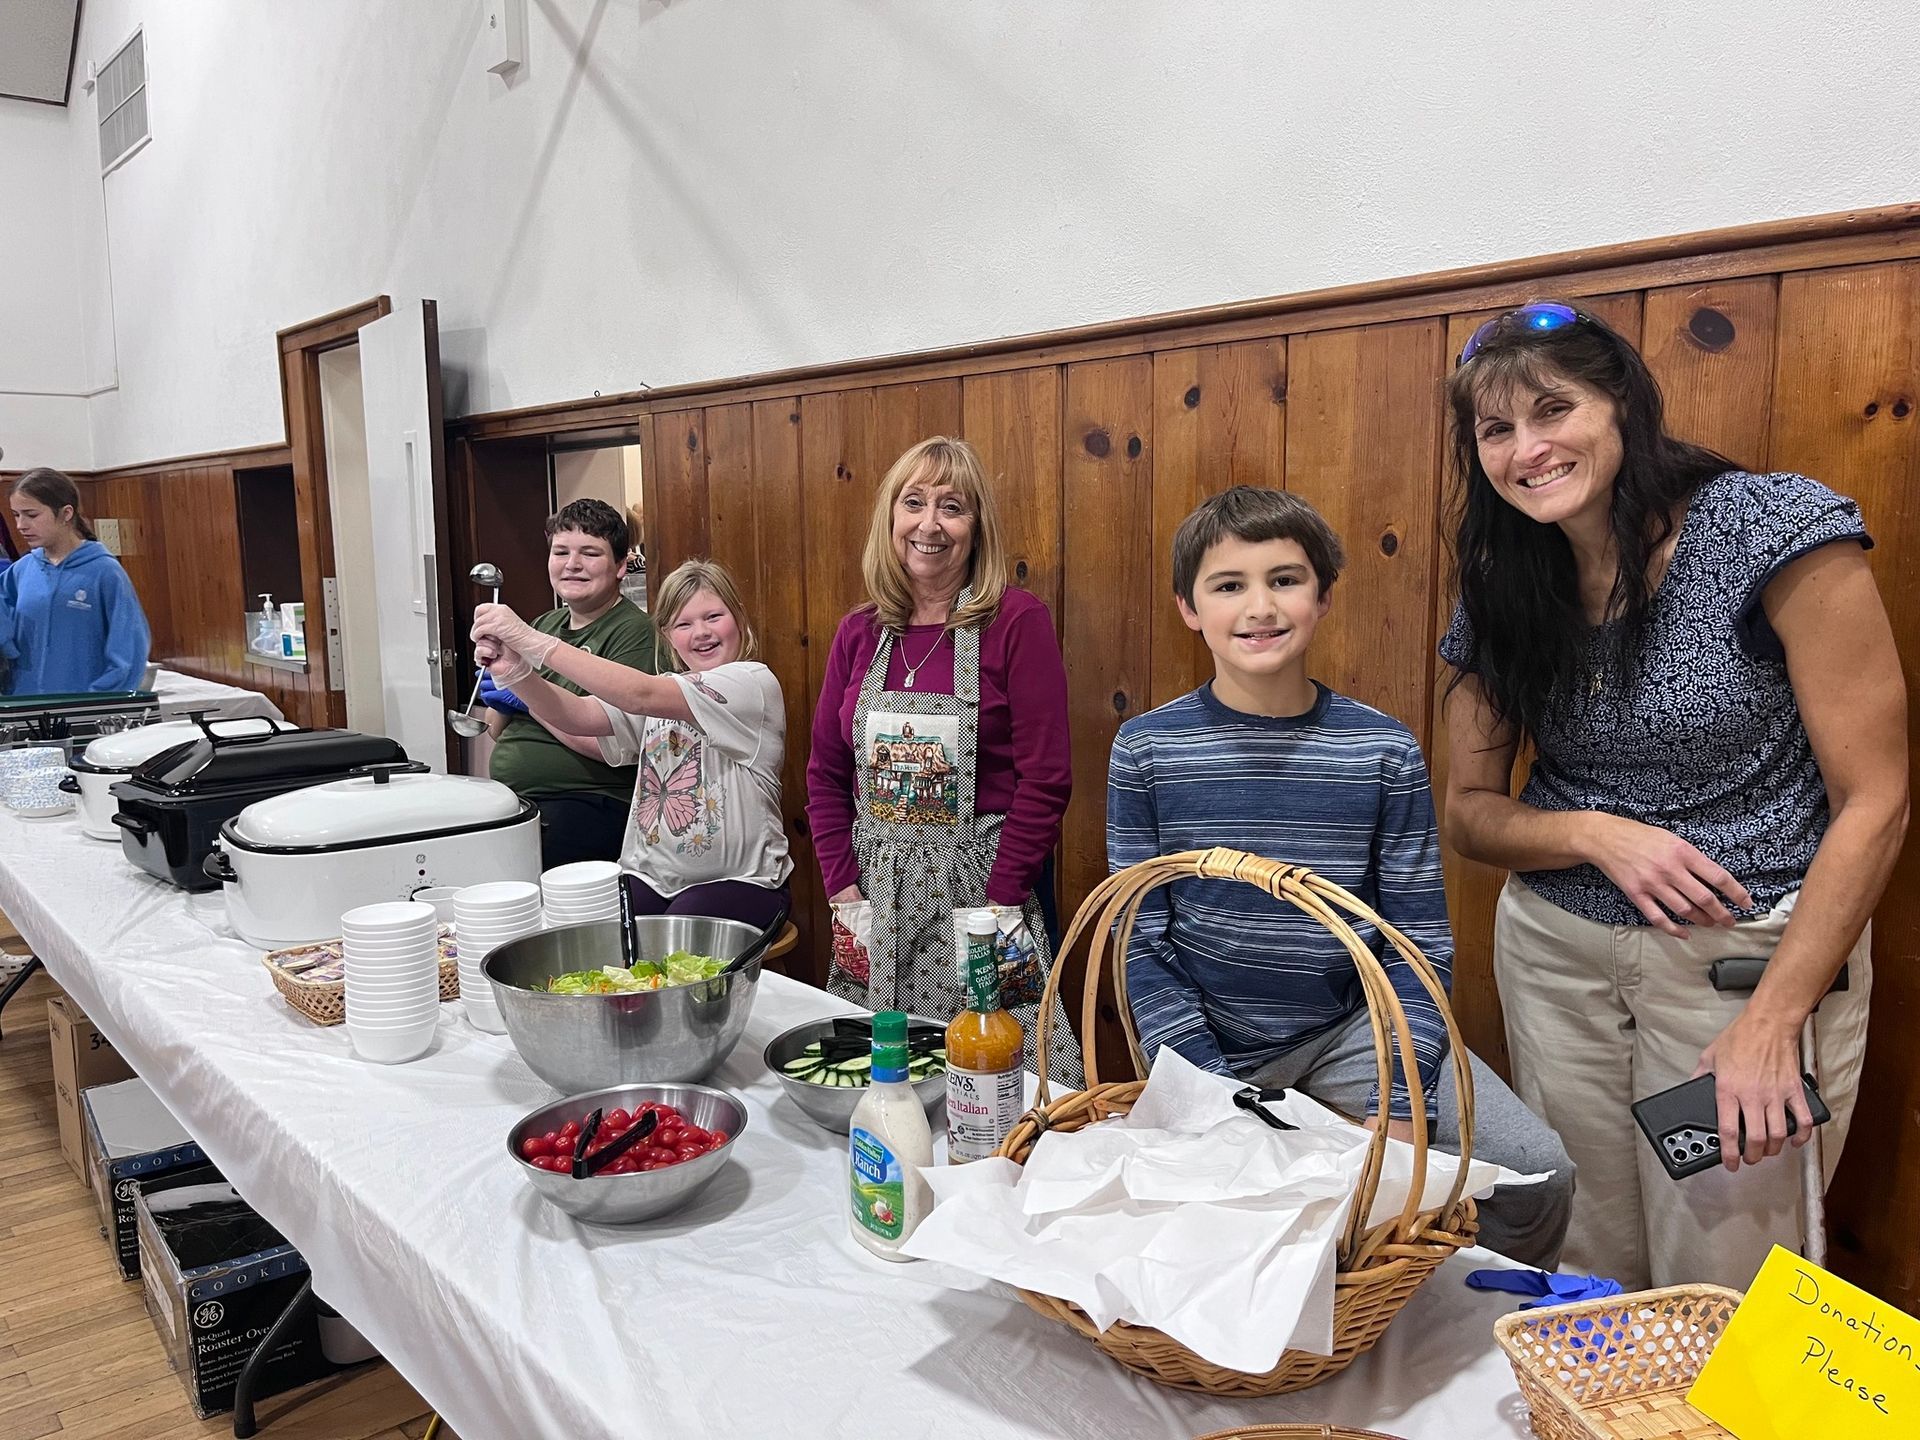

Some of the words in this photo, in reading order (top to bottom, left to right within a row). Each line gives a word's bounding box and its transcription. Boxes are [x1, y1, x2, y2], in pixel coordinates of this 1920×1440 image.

[957, 1100, 988, 1114] Italian
[854, 1151, 881, 1179] Ranch
[197, 1329, 230, 1344] 18-Quart
[198, 1333, 244, 1355] Roaster
[1801, 1336, 1889, 1415] Please
